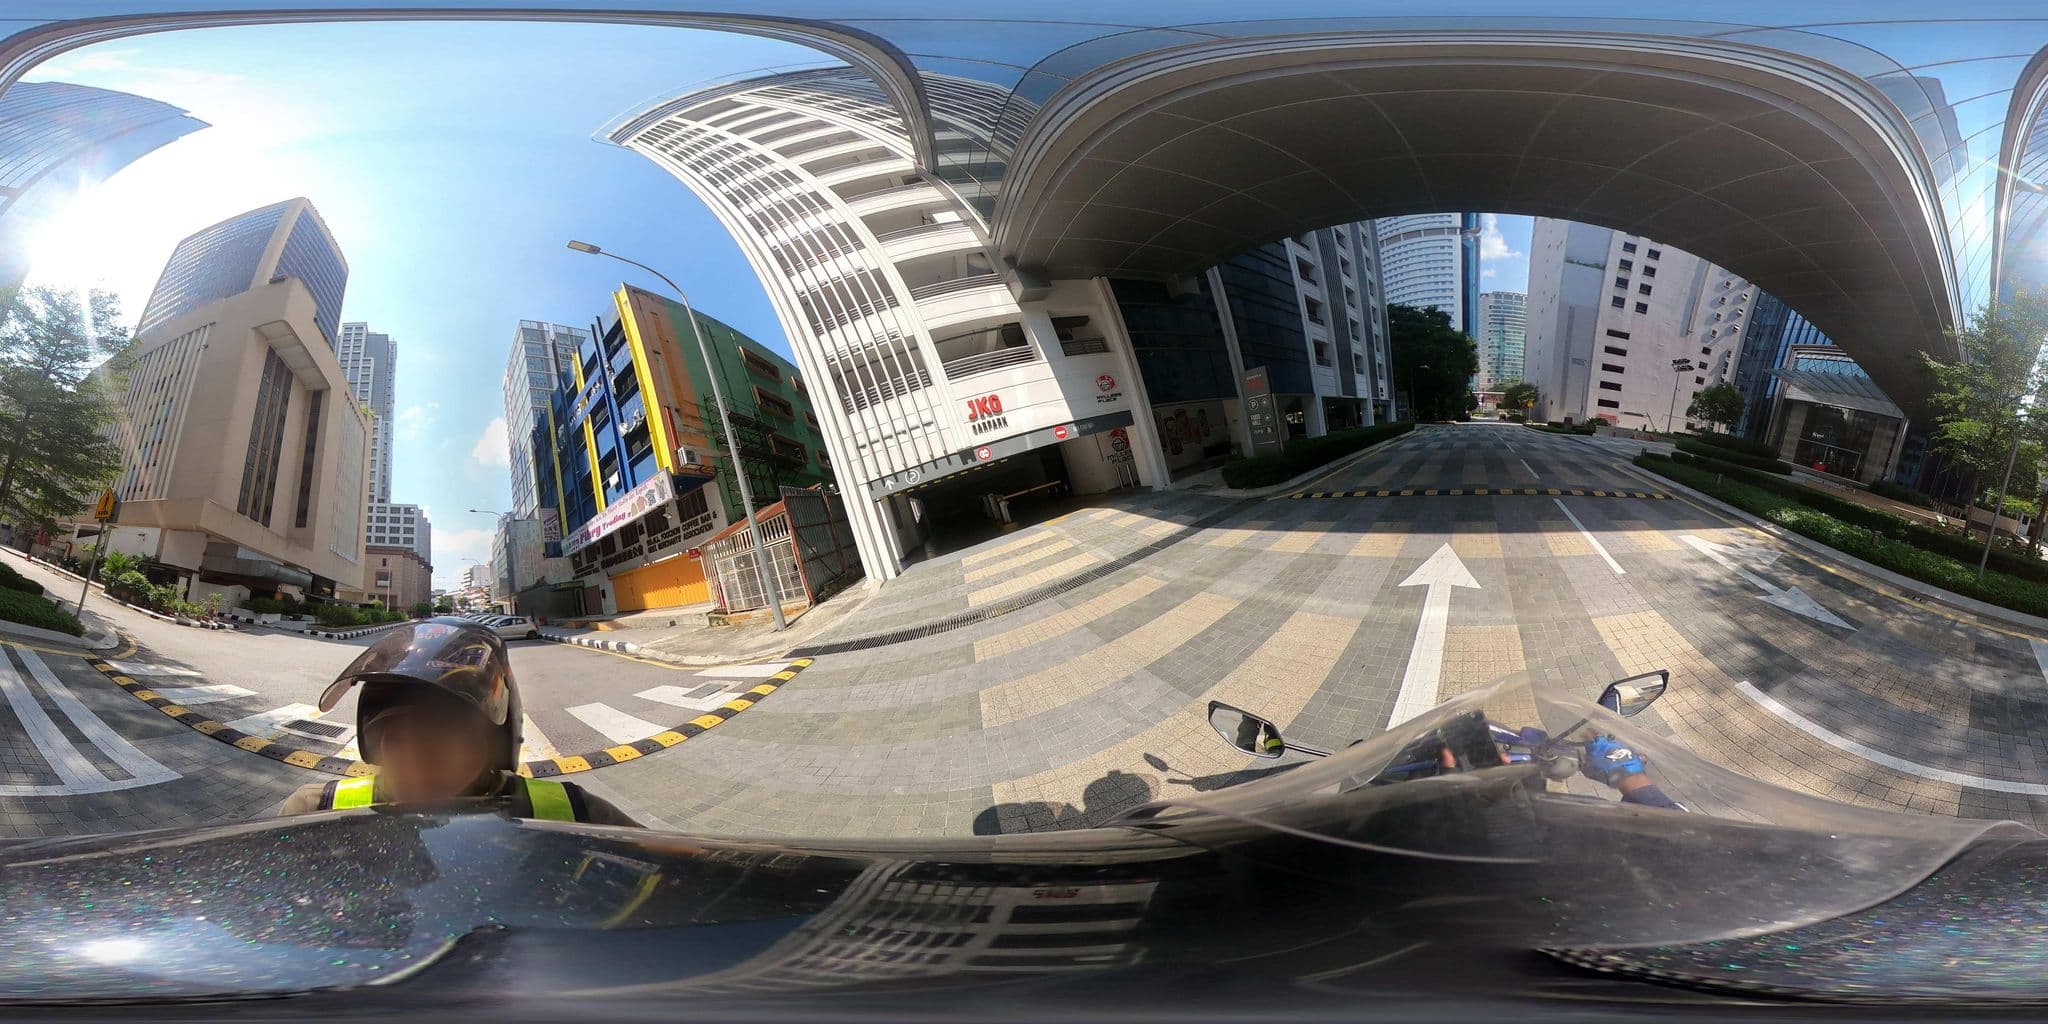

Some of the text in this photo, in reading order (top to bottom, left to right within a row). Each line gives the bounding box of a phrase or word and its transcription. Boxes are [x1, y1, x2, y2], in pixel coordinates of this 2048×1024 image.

[967, 394, 1003, 422] JKG
[972, 416, 1009, 436] CARPARK
[682, 518, 700, 532] COFFEE
[701, 514, 712, 524] BAR
[712, 510, 718, 520] &
[683, 521, 714, 540] ASSOCIATION
